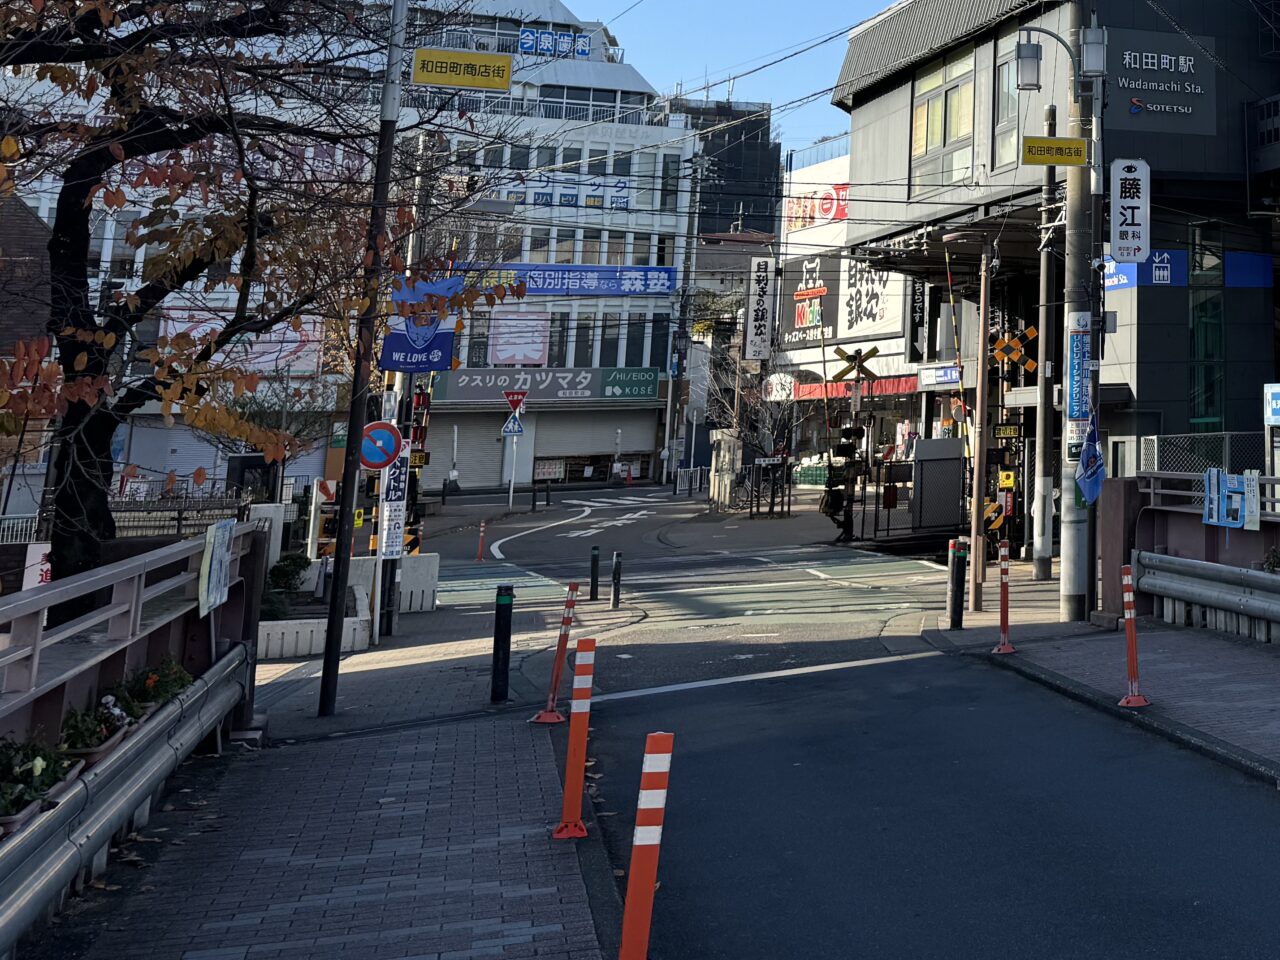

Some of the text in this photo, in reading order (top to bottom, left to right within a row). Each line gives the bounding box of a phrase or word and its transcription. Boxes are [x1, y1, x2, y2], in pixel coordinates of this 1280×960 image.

[521, 32, 589, 53] 今泉歯科
[420, 59, 506, 79] 和田町商店街
[1123, 51, 1194, 73] 和田町駅
[1118, 77, 1204, 93] Wadamachi Sta.
[1146, 103, 1192, 113] SOTETSU
[1027, 145, 1083, 157] 和田町商店街
[1119, 177, 1141, 227] 藤江
[1119, 230, 1141, 241] 眼科
[754, 261, 769, 337] 目利きの銀次
[392, 351, 405, 361] WE
[406, 352, 428, 362] LOVE
[607, 370, 654, 381] SHISEIDO
[625, 385, 653, 395] KOSÉ
